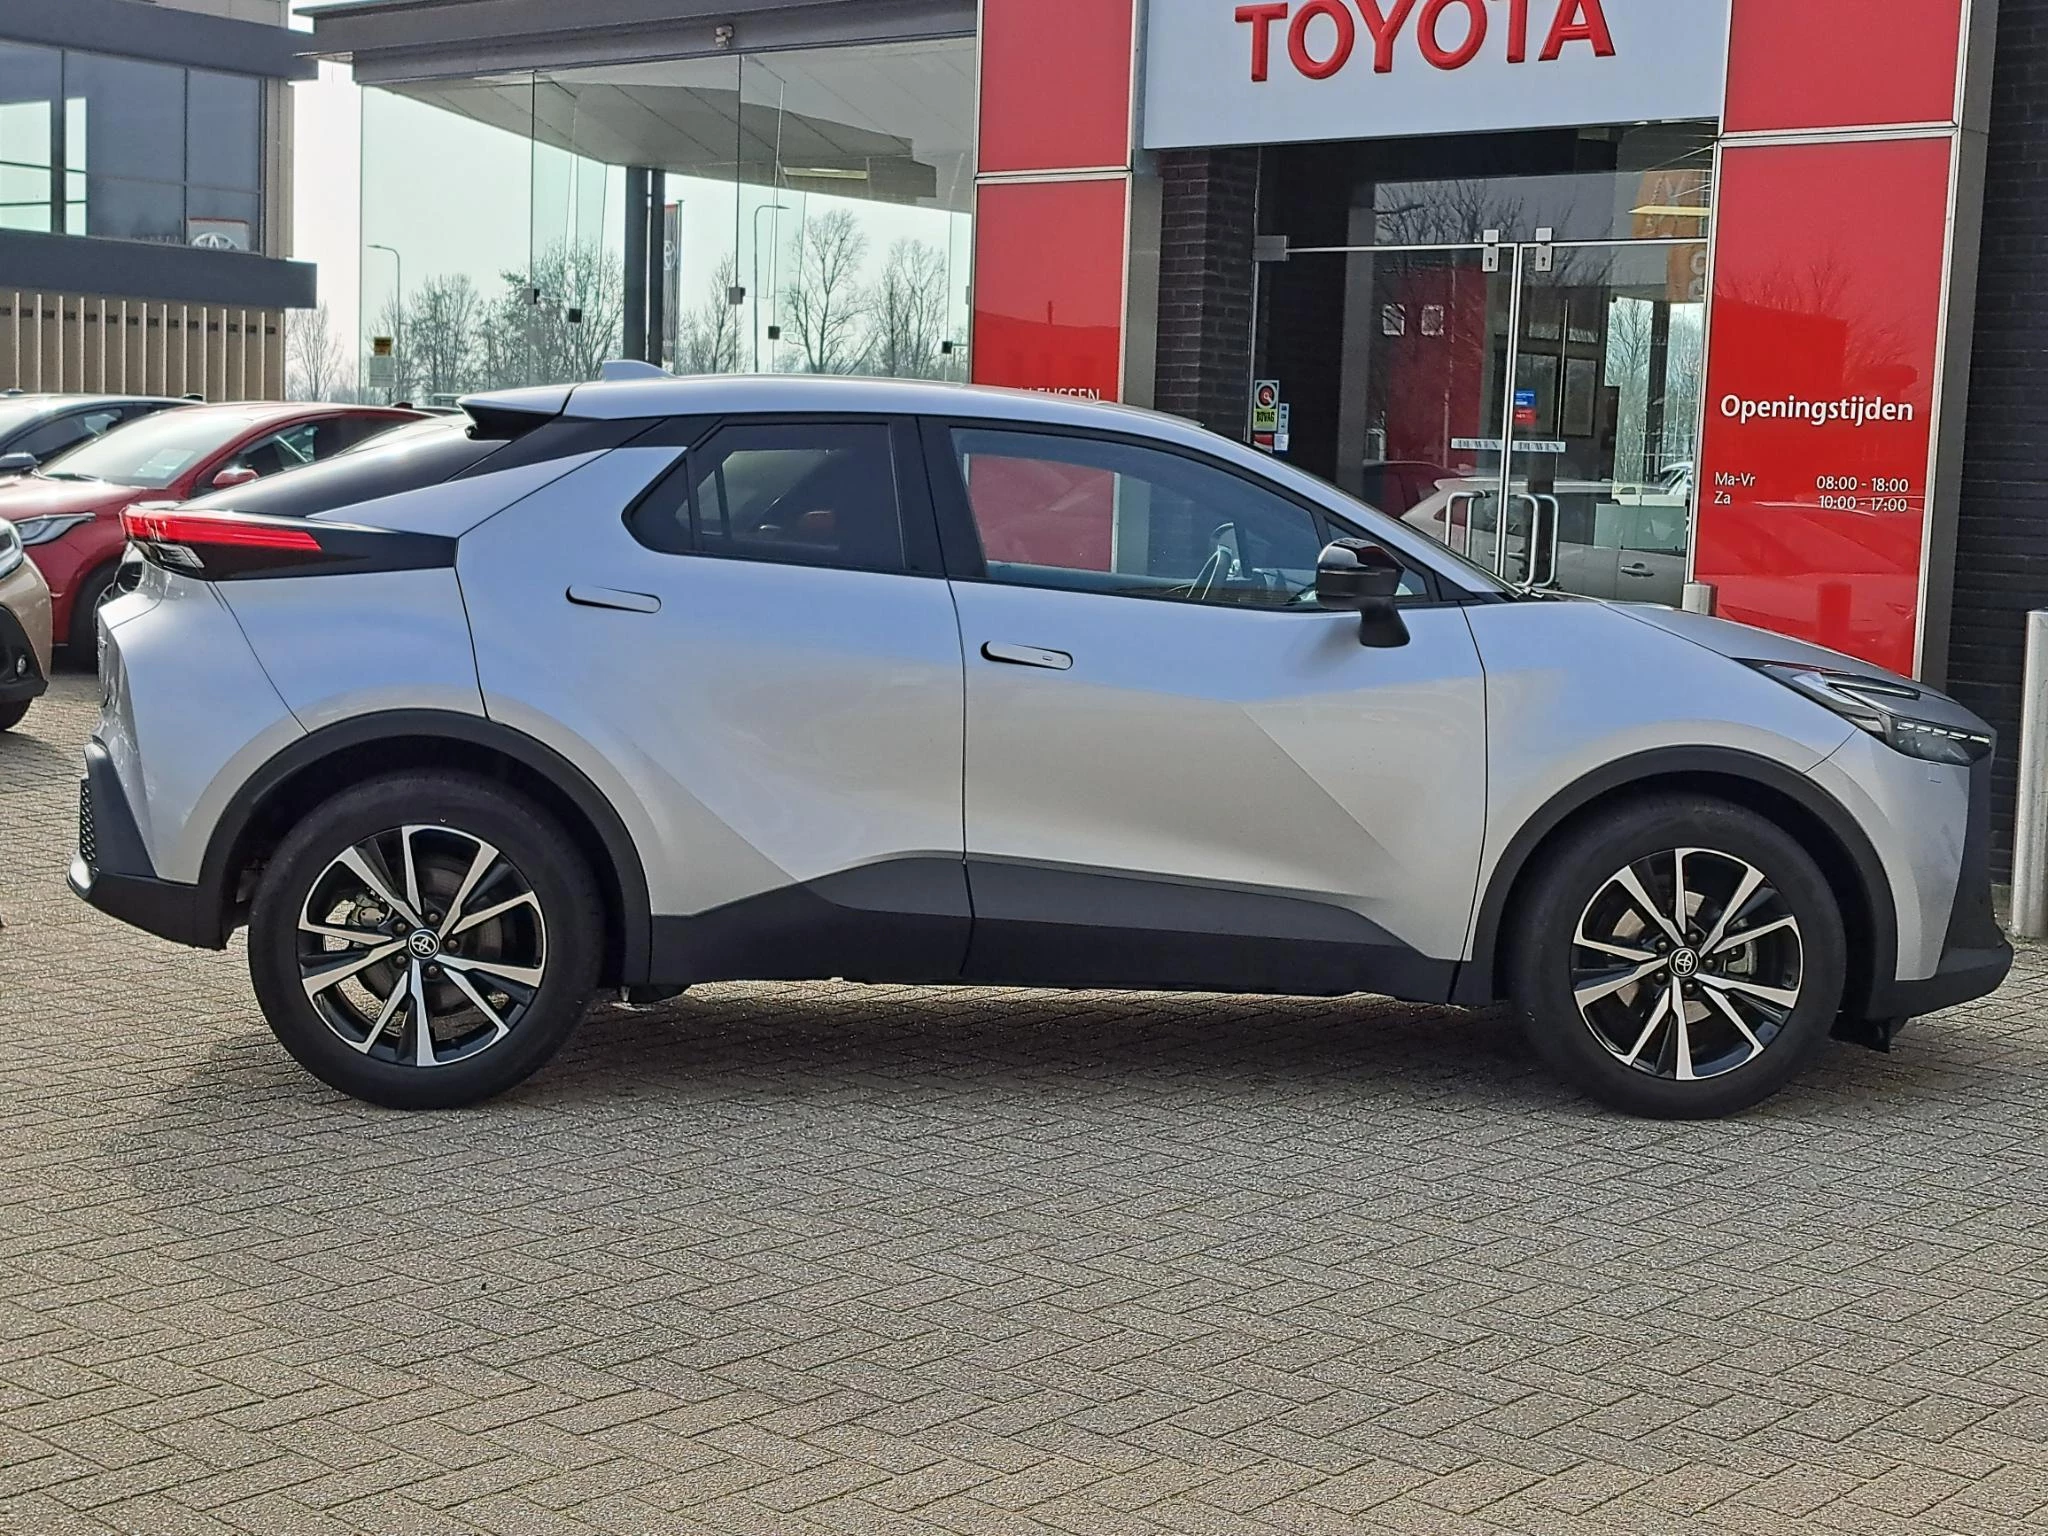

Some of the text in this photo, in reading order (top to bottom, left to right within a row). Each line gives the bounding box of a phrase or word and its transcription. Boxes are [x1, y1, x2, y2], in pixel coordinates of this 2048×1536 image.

[1234, 0, 1616, 82] TOYOTA
[1720, 394, 1914, 426] Openingstijden
[1714, 472, 1755, 487] Ma-Vr
[1816, 475, 1858, 491] 08:00
[1871, 477, 1909, 493] 18:00
[1714, 491, 1731, 505] Za
[1819, 495, 1856, 510] 10:00
[1870, 497, 1907, 512] 17:00
